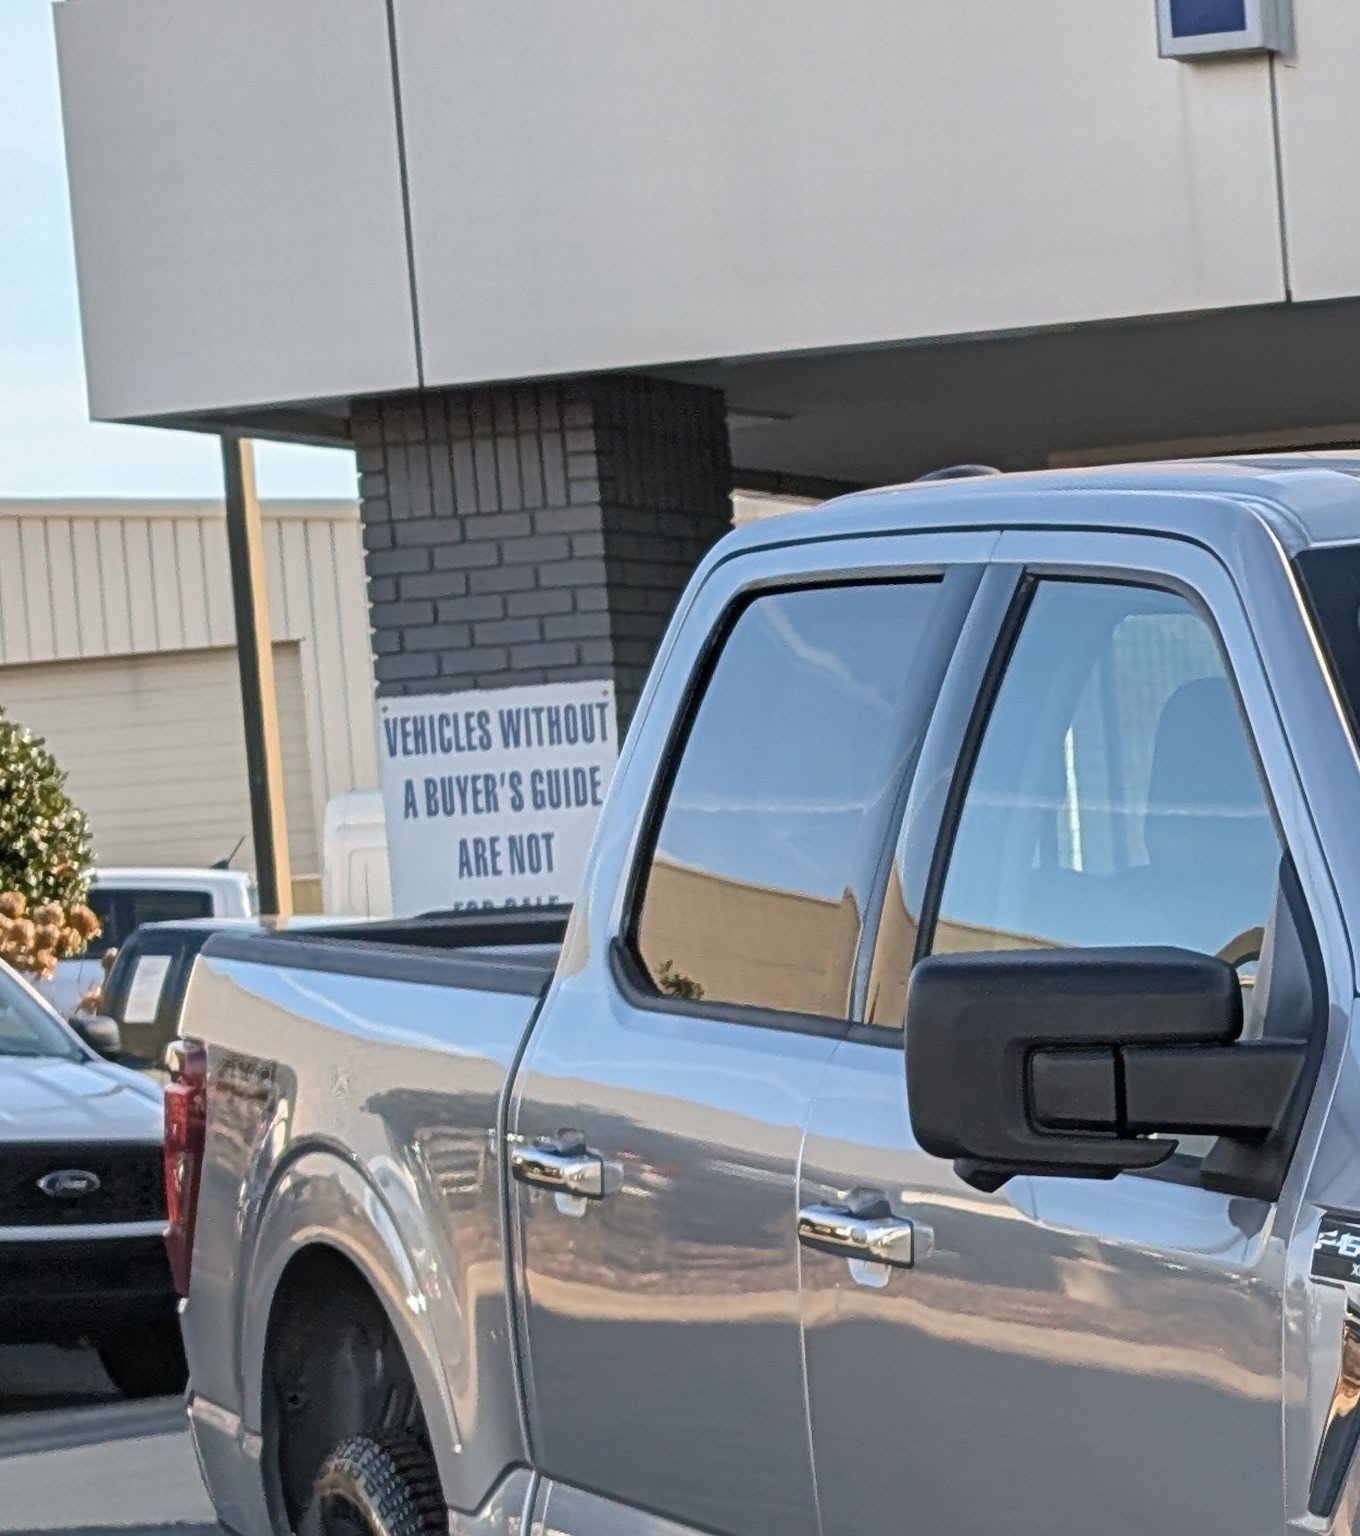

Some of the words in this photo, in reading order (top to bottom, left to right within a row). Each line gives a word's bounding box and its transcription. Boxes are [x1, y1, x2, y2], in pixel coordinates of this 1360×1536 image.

[383, 709, 493, 758] VEHICLES
[498, 702, 609, 750] WITHOUT
[403, 777, 419, 820] A
[424, 769, 525, 819] BUYER'S
[530, 765, 604, 811] GUIDE
[457, 835, 503, 879] ARE
[508, 831, 555, 876] NOT
